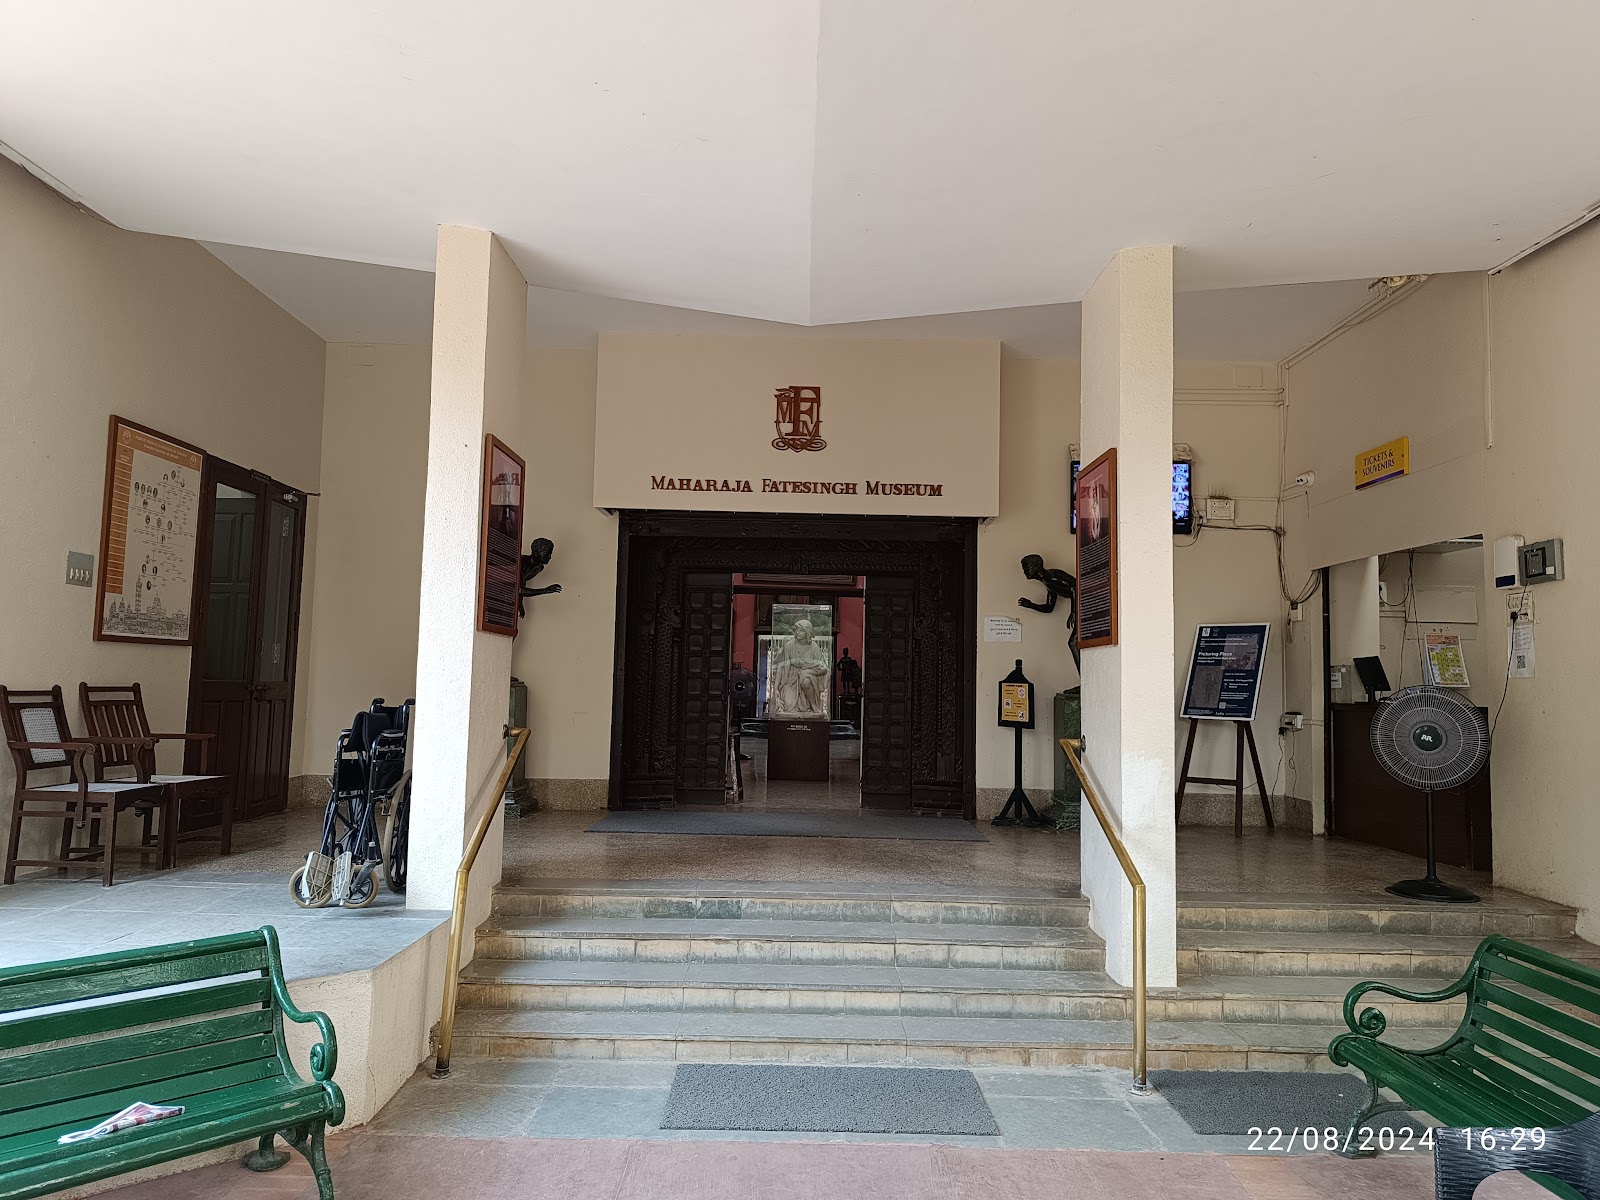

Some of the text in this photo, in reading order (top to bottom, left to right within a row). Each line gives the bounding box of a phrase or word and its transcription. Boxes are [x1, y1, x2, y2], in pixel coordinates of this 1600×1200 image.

[1363, 448, 1394, 467] TICKETS &
[1362, 458, 1395, 477] SOUVENIRS
[650, 475, 944, 497] MAHARAJA FATESINGH MUSEUM
